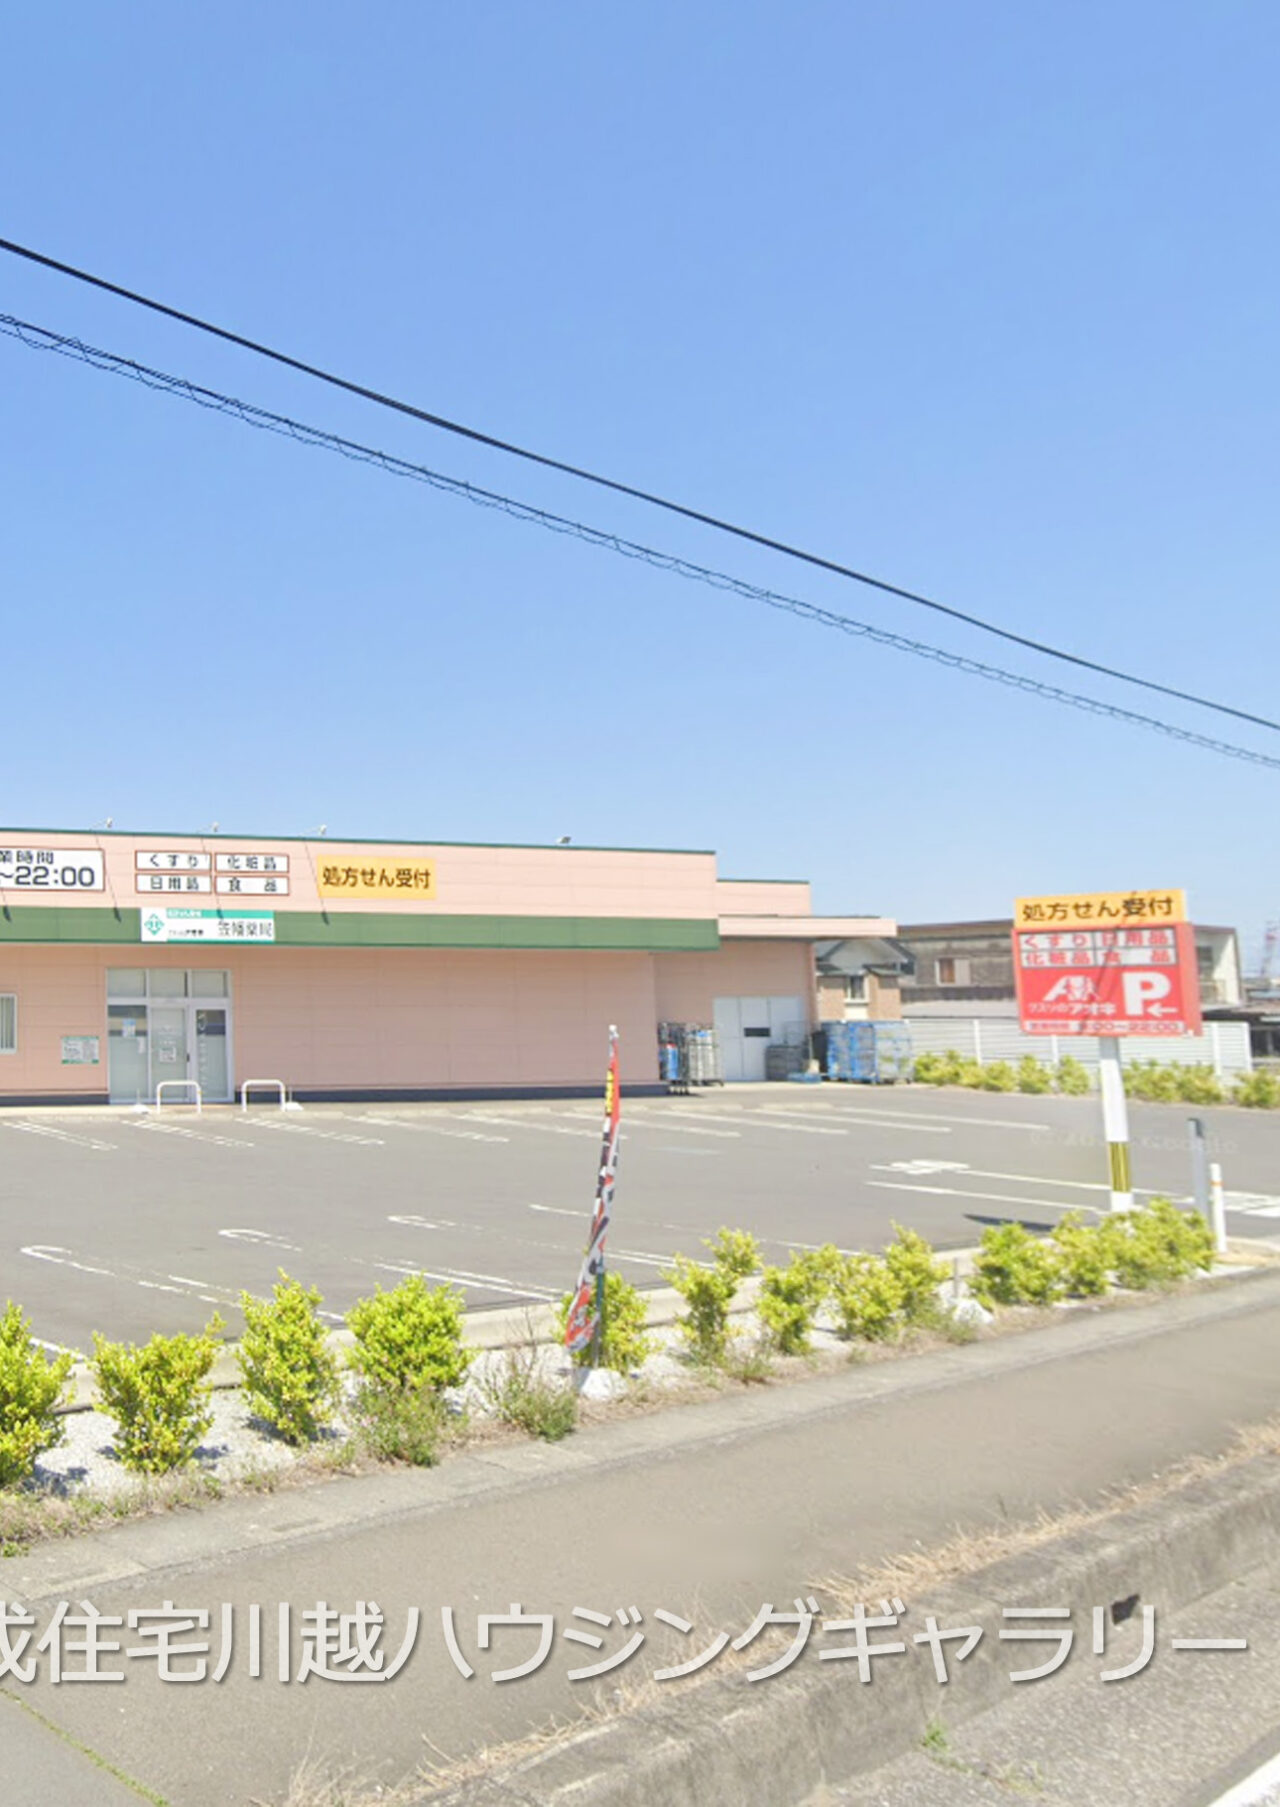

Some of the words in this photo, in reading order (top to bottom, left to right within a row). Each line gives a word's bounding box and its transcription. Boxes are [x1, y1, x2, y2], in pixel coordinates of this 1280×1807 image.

[149, 855, 199, 867] くすり
[227, 857, 277, 870] 化粧品
[150, 877, 200, 891] 日用品
[322, 866, 431, 889] 処方せん受付
[1022, 896, 1174, 922] 処方せん受付
[1024, 933, 1088, 949] くすり
[1122, 971, 1172, 1016] P
